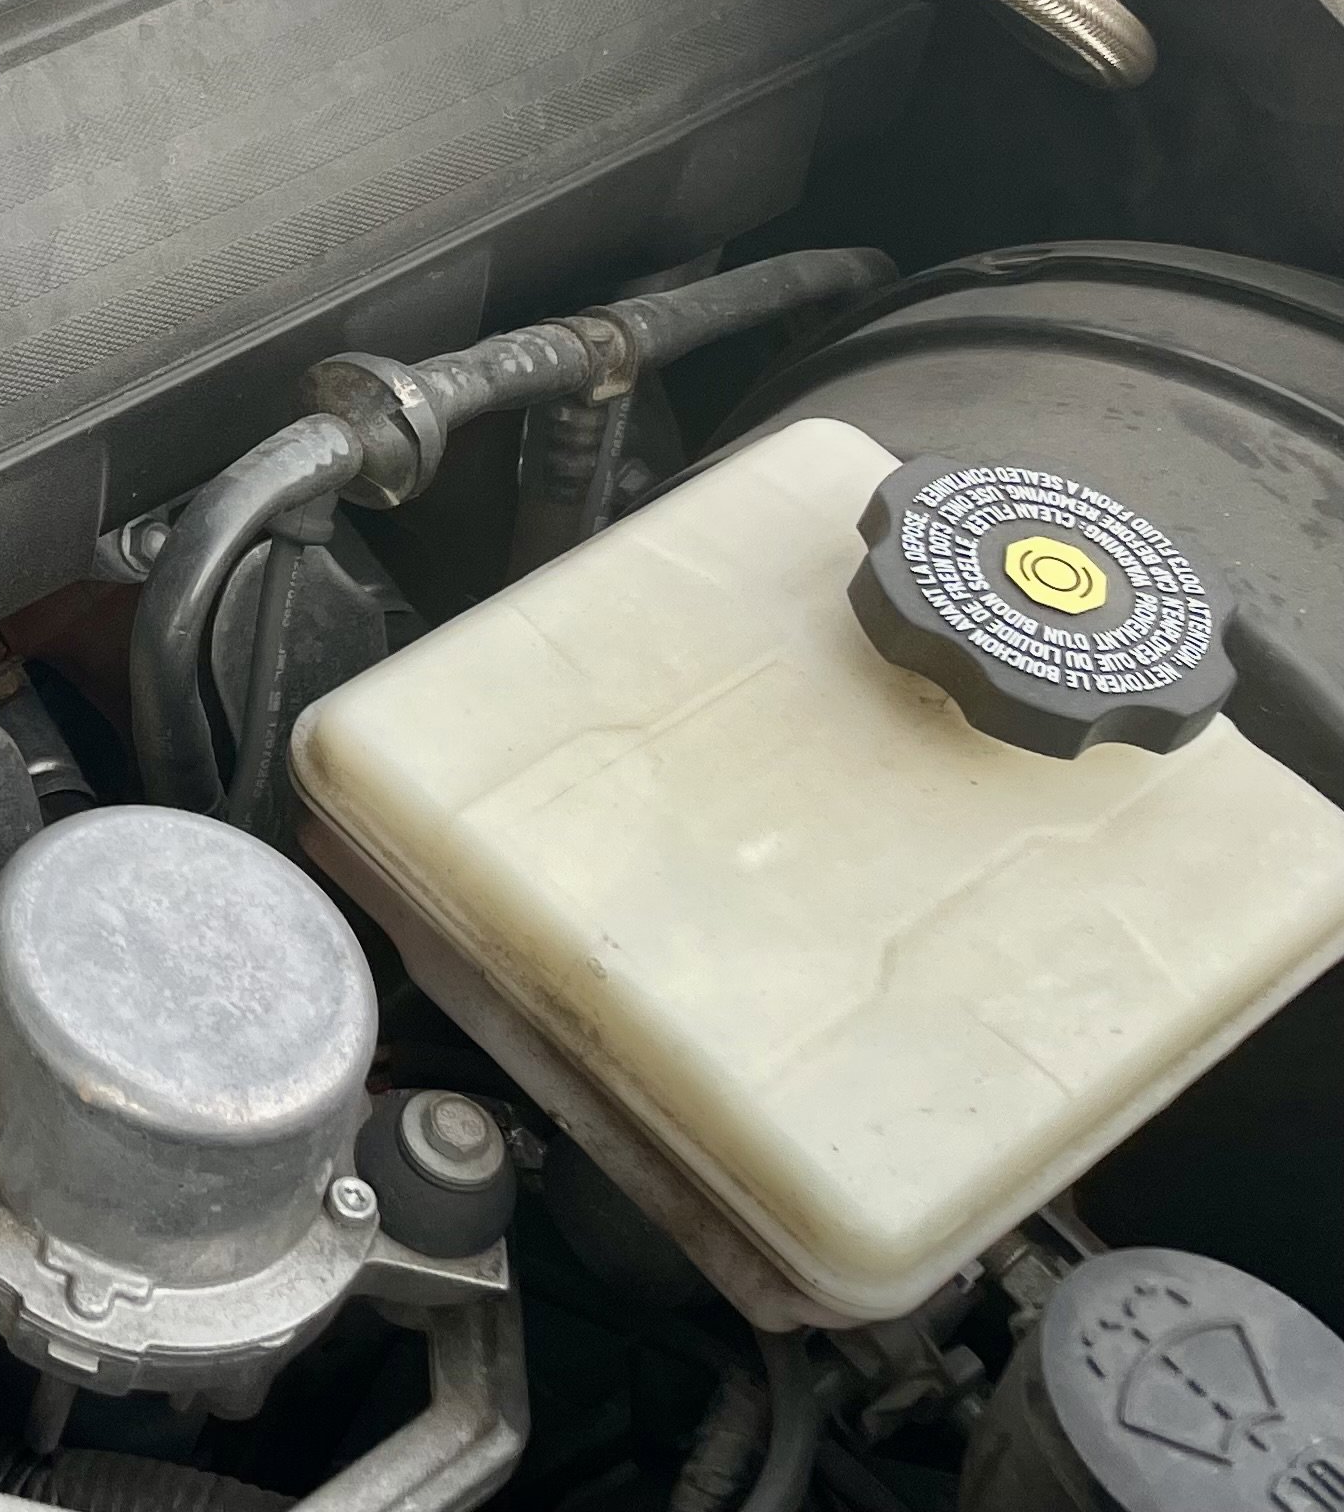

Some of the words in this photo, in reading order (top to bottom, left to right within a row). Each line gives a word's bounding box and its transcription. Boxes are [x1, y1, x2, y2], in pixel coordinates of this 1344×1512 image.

[994, 467, 1063, 491] SEALED
[1066, 479, 1080, 495] A
[937, 495, 975, 526] ONLY
[964, 485, 1006, 507] USE
[1080, 487, 1135, 522] FROM
[962, 503, 1017, 536] FILLER
[1013, 503, 1076, 529] CLEAN
[928, 521, 954, 557] DOT3
[1078, 520, 1153, 588] WARNING:
[1098, 514, 1162, 566] BEFORE
[1130, 518, 1180, 557] FLUID
[909, 564, 937, 585] LA
[931, 557, 973, 601] FREIN
[1149, 566, 1180, 593] CAP
[1167, 557, 1206, 594] DOT3
[921, 587, 977, 631] AVANT
[961, 600, 992, 623] DE
[979, 592, 1039, 636] BIDON
[1092, 591, 1158, 651] PROVENANT
[967, 628, 1061, 684] BOUCHON
[985, 618, 1062, 665] LIQUIDE
[1065, 650, 1094, 671] DU
[1093, 652, 1137, 672] QUE
[1065, 668, 1091, 692] LE
[1092, 661, 1183, 694] NETTOYER
